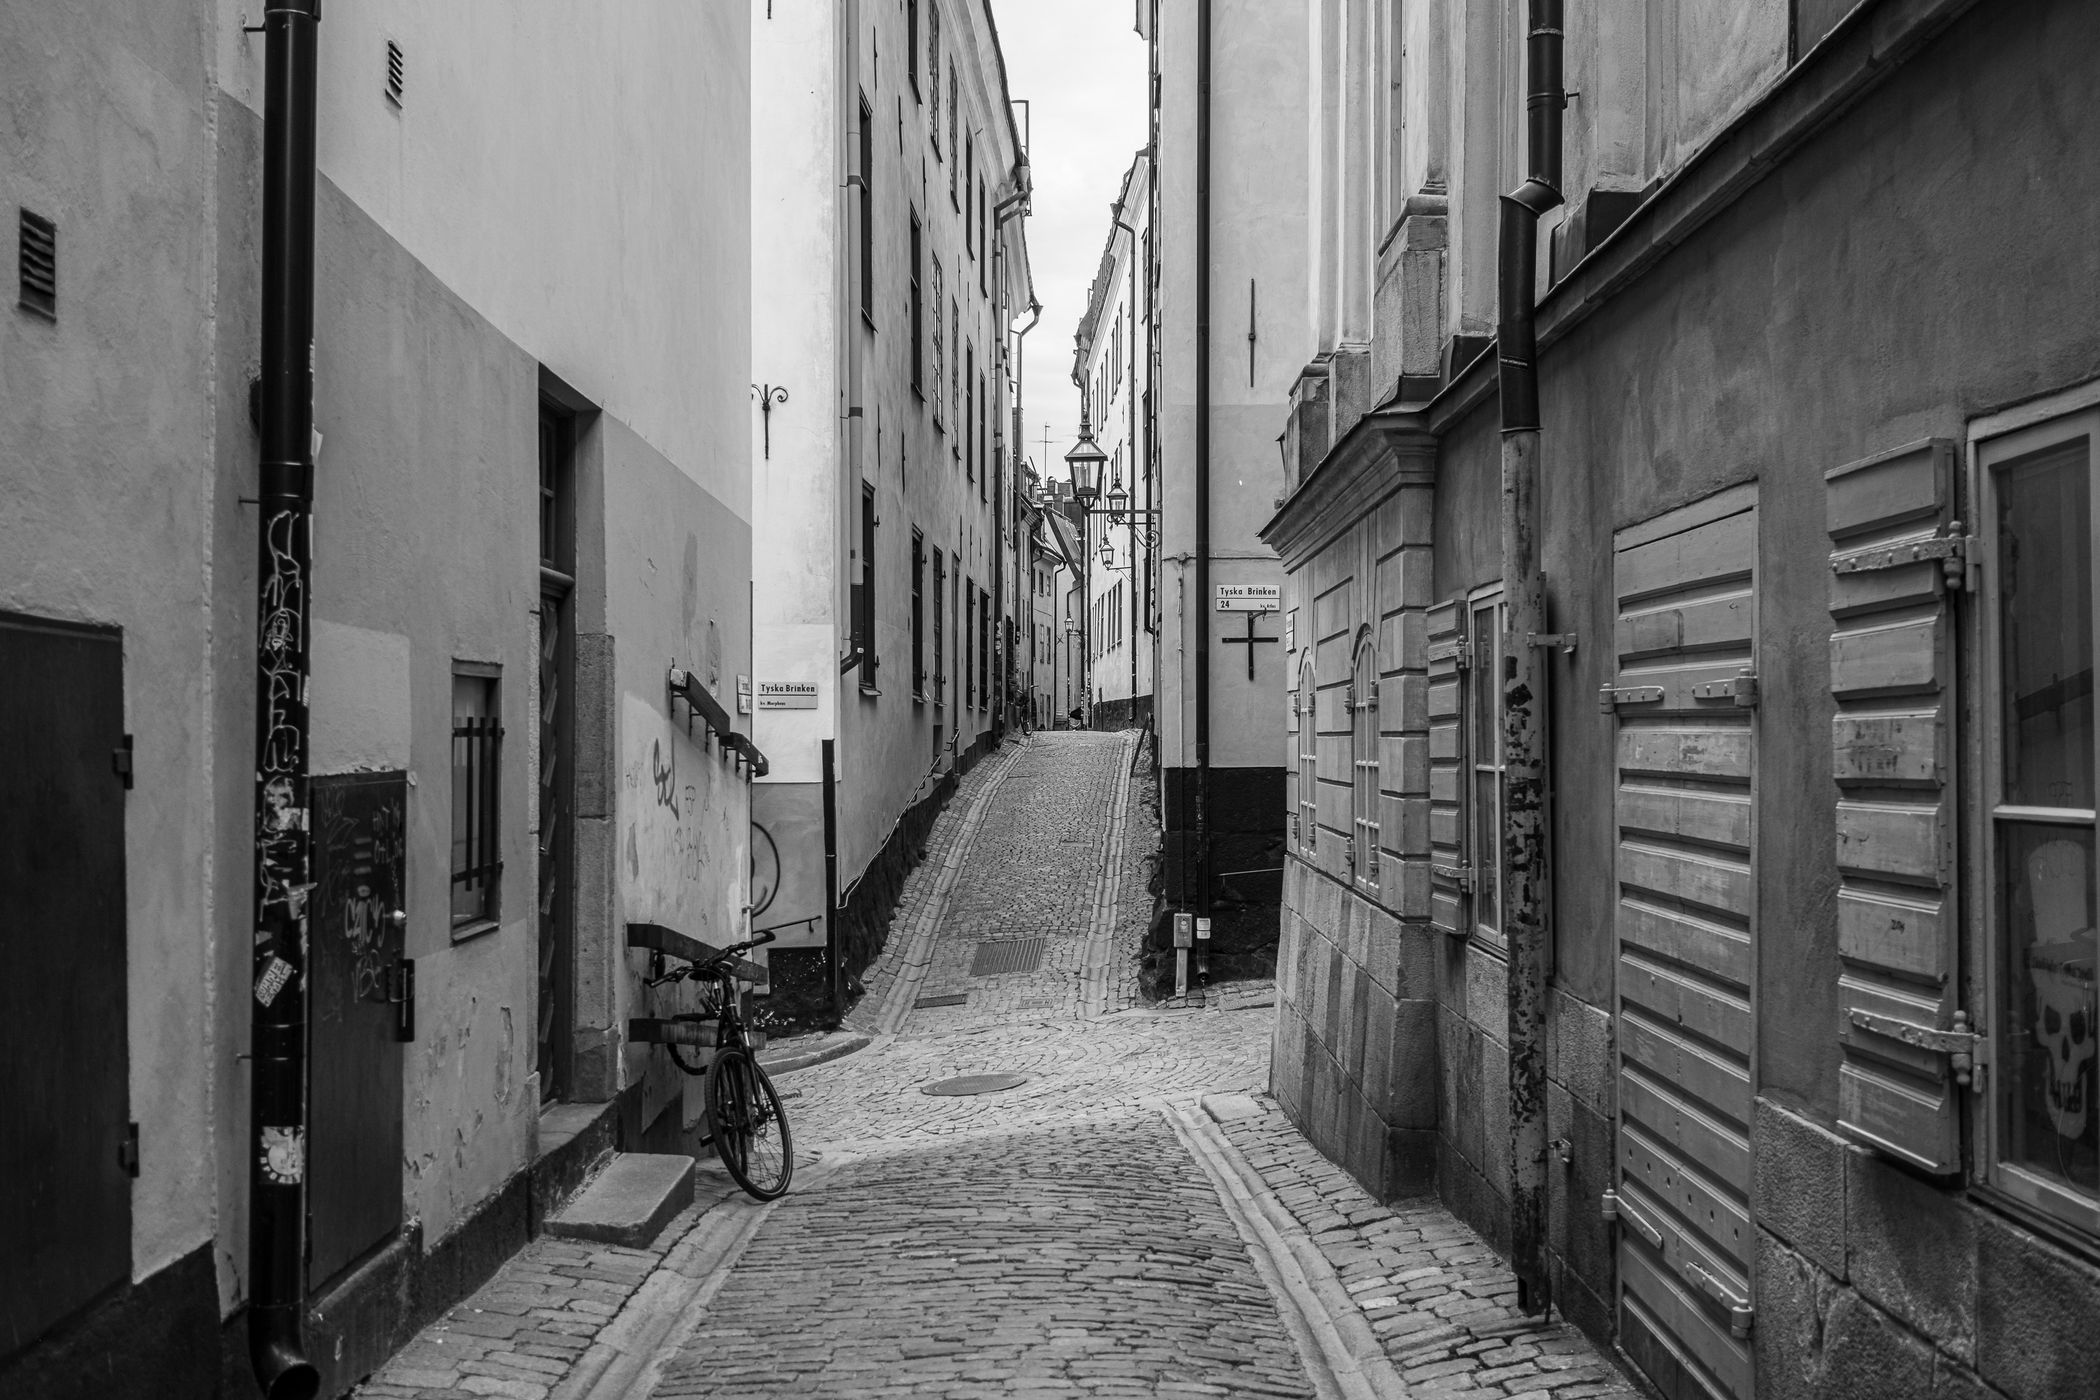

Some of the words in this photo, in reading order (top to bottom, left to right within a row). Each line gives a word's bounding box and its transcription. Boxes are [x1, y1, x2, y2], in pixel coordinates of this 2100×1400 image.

[1220, 586, 1243, 597] Tyska
[1247, 586, 1277, 596] Brinken
[1220, 600, 1230, 608] 24
[761, 683, 784, 694] Tyska
[785, 683, 815, 692] Brinken
